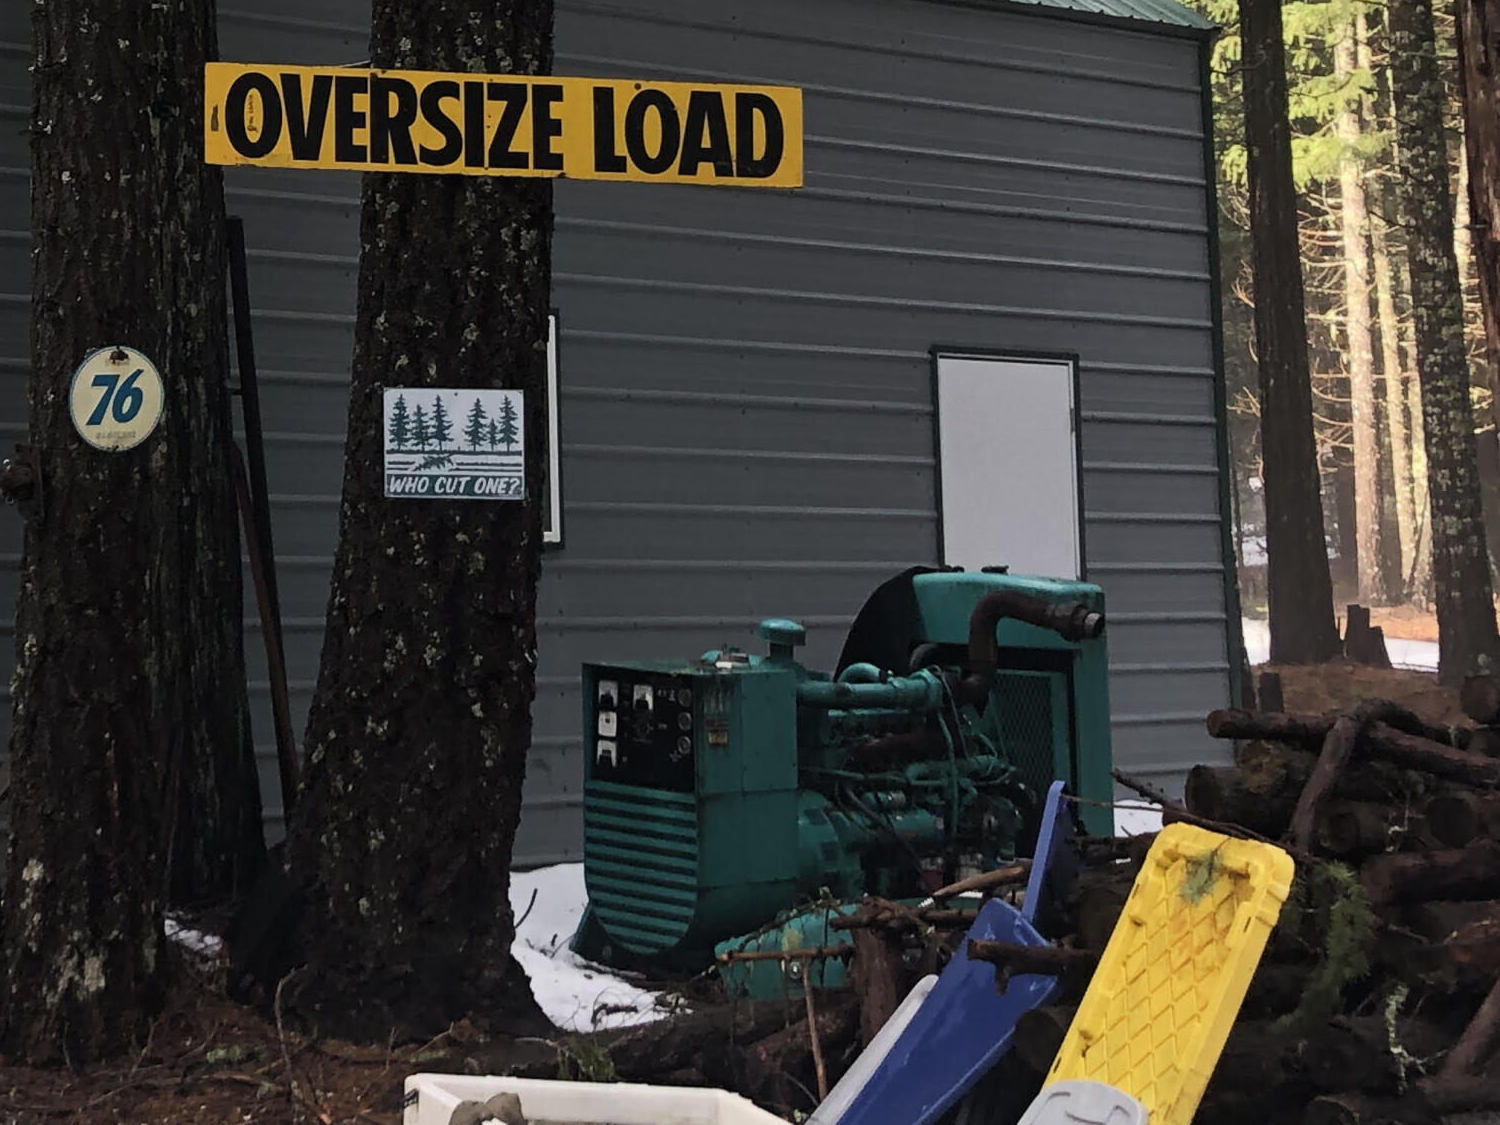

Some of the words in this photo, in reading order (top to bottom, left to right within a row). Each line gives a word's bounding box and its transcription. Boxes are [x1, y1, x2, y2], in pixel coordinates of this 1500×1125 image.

[225, 71, 565, 171] OVERSIZE
[593, 86, 785, 179] LOAD
[85, 368, 145, 426] 76
[389, 476, 430, 493] WHO
[434, 476, 471, 494] CUT
[473, 477, 520, 495] ONE?
